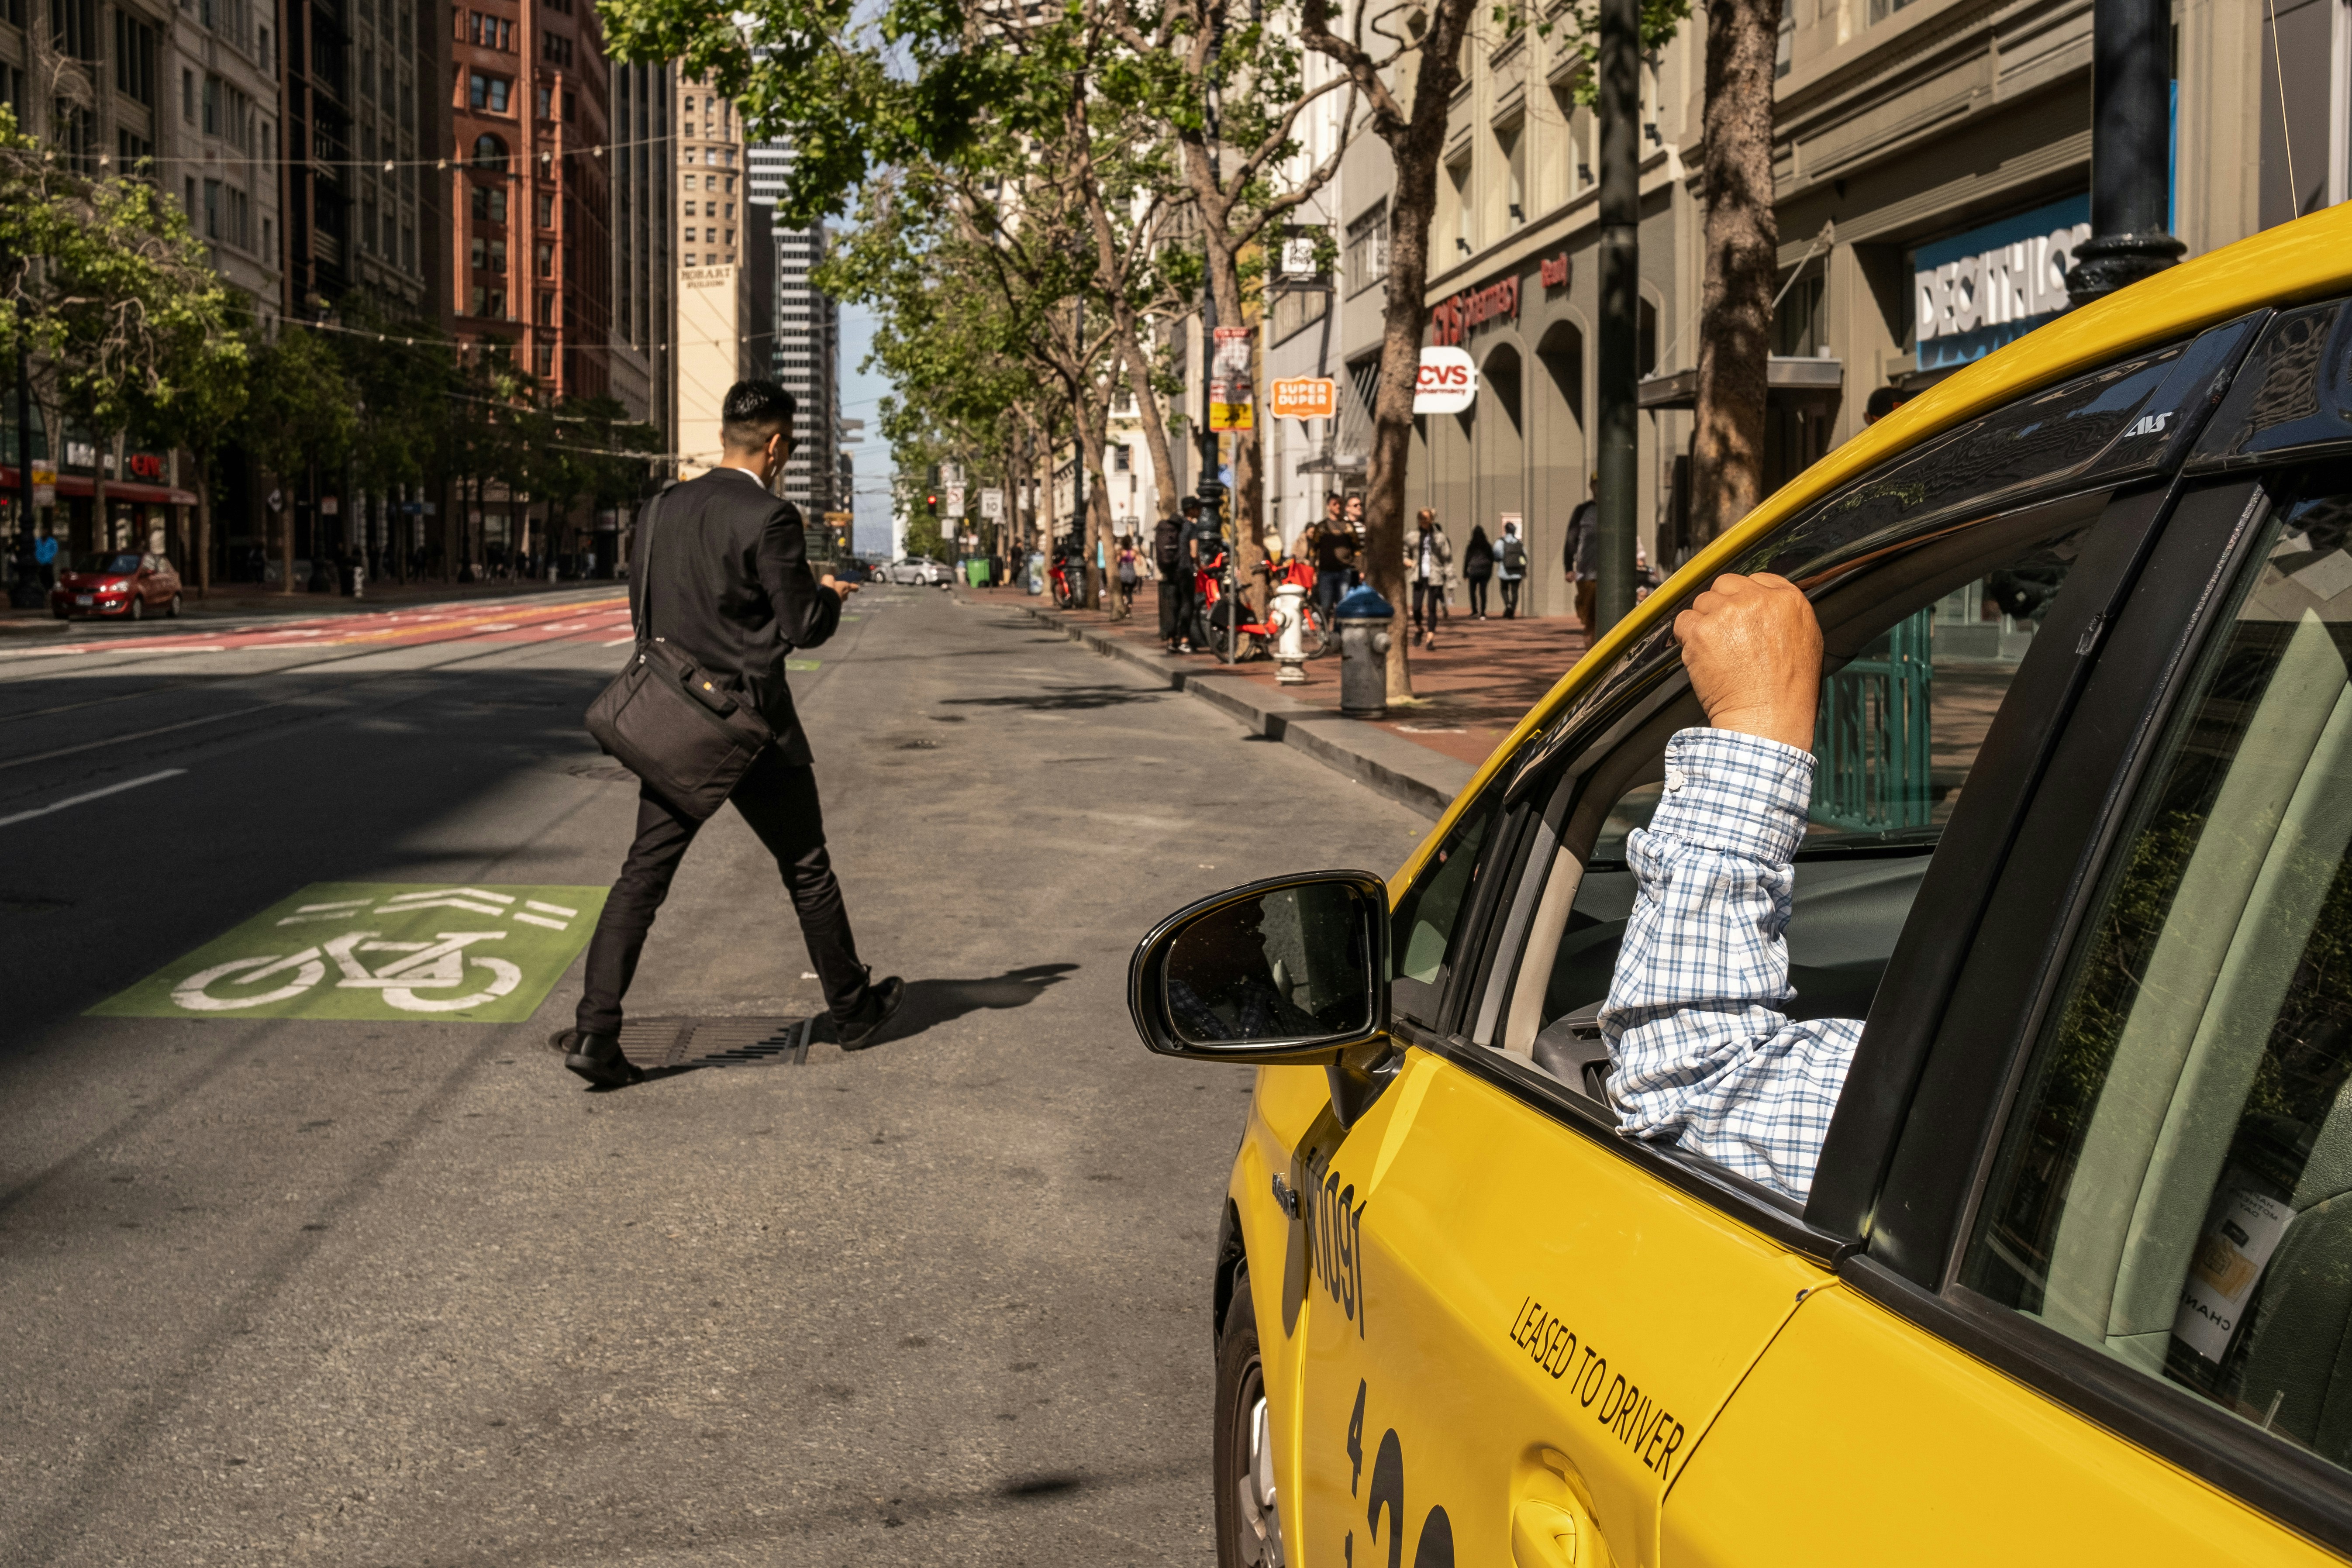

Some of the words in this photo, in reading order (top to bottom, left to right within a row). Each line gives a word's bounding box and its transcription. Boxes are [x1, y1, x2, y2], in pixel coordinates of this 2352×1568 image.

[682, 267, 730, 280] HOBART
[1417, 365, 1468, 385] CVS
[1279, 383, 1327, 394] SUPER
[1278, 394, 1327, 405] DUPER
[986, 502, 999, 512] 10
[1510, 1296, 1577, 1379] LEASED
[1571, 1345, 1607, 1408] TO
[1598, 1373, 1685, 1481] DRIVER
